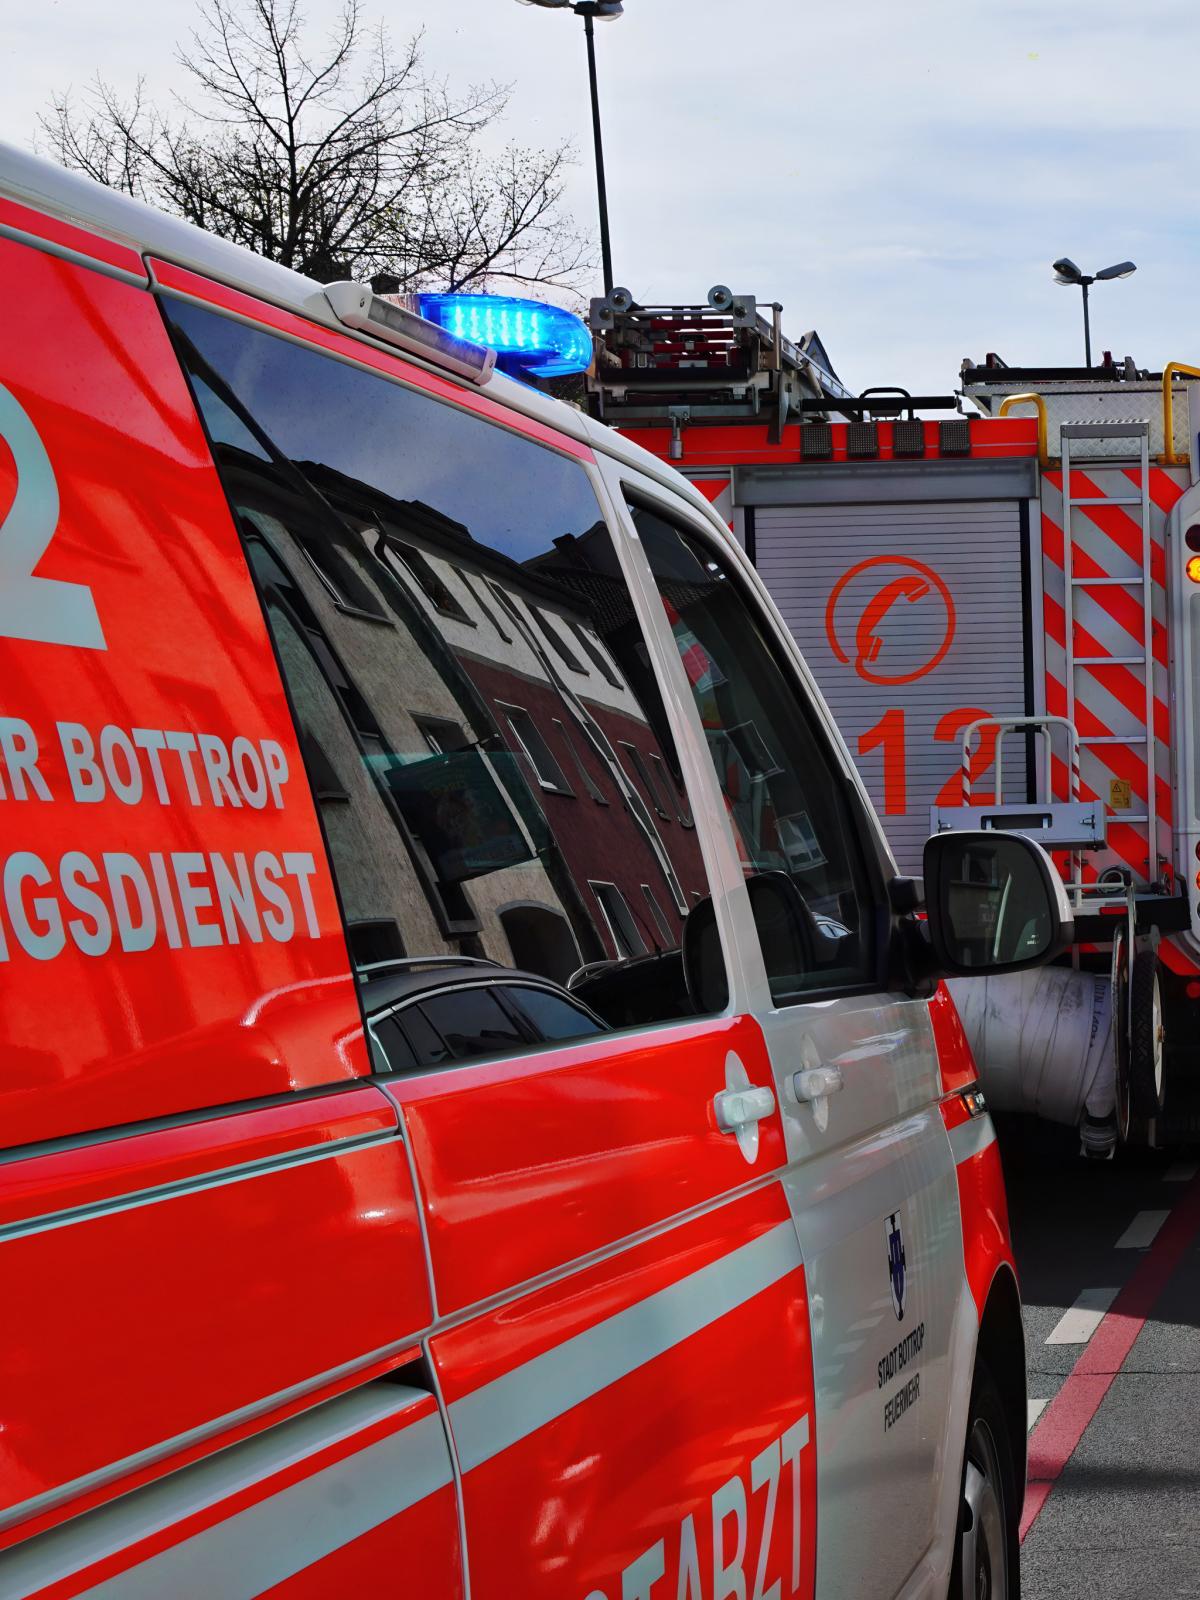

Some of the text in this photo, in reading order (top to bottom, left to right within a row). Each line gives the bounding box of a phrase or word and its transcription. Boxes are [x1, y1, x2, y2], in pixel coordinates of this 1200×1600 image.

[0, 716, 289, 810] R BOTTROP
[858, 707, 1004, 816] 12
[0, 851, 321, 962] GSDIENST
[877, 1321, 925, 1389] STADT BOTTROP
[884, 1372, 921, 1432] FEUERWEHR
